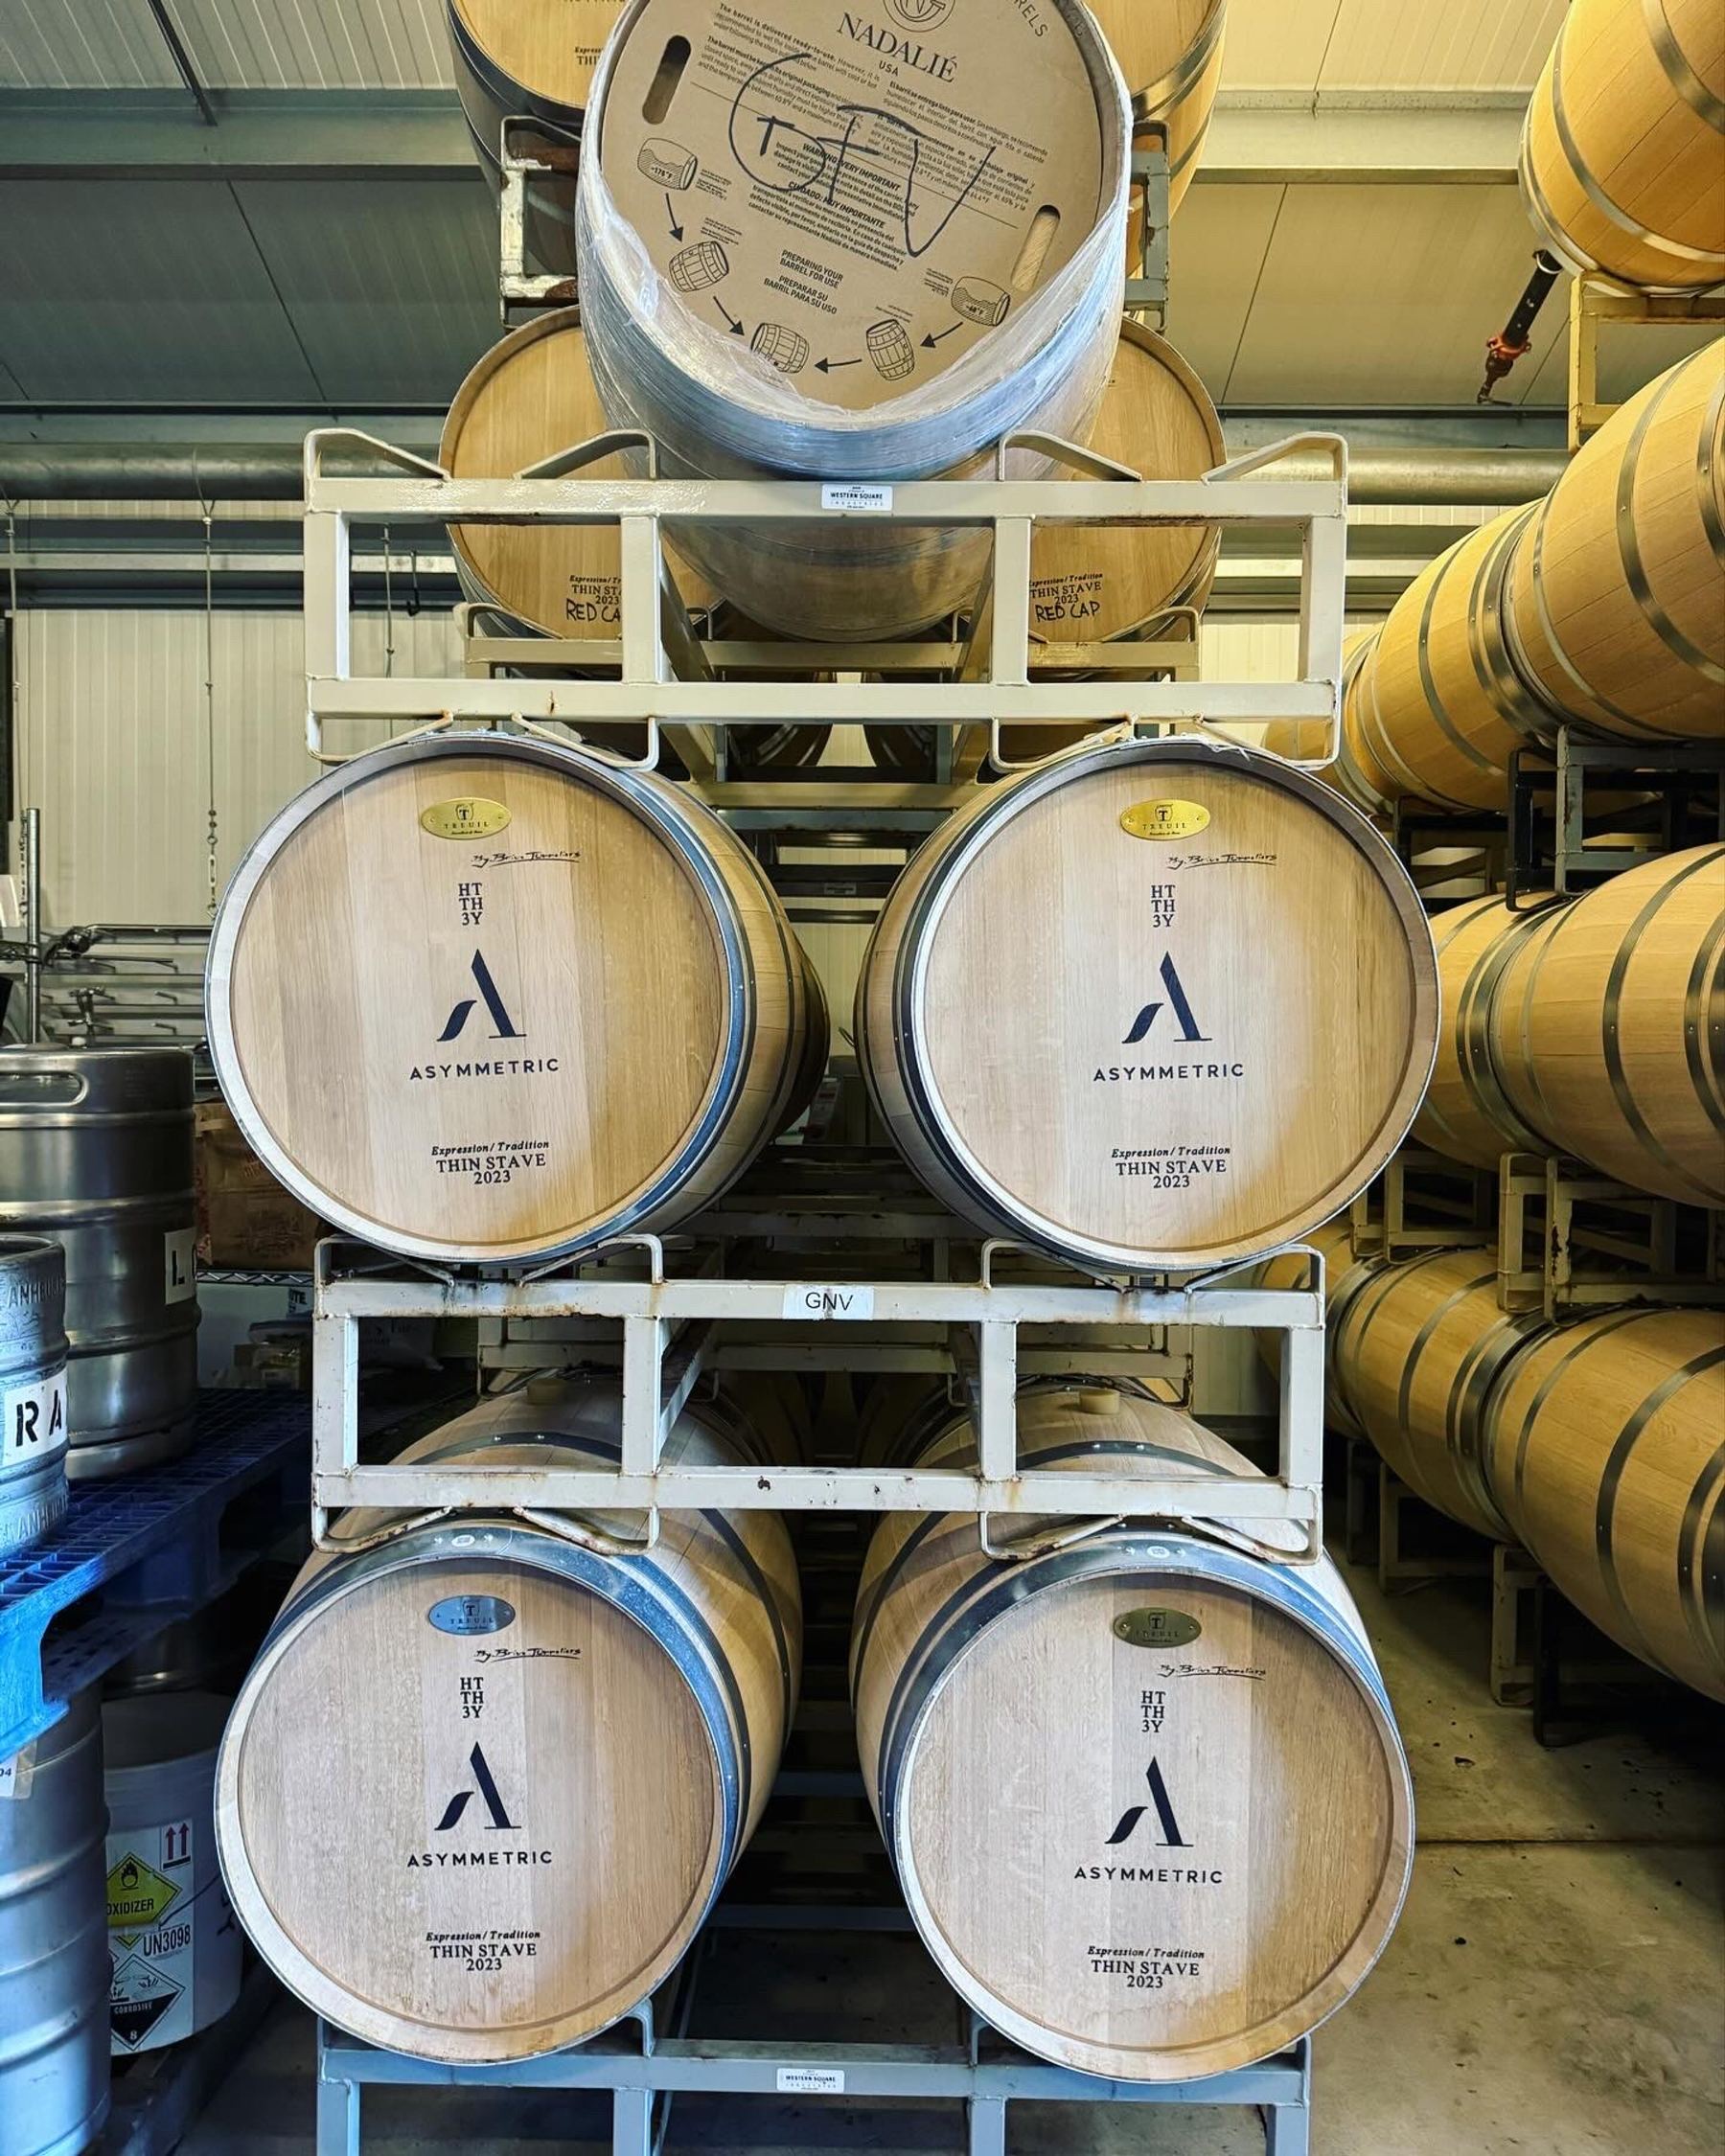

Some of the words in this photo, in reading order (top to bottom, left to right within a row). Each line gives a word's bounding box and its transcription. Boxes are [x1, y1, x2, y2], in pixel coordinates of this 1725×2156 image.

[836, 12, 958, 83] NADALIÉ
[879, 60, 900, 77] USA
[858, 168, 901, 192] IMPORTANT
[839, 202, 886, 228] IMPORTANTE
[778, 257, 809, 275] BARREL
[807, 269, 825, 282] FOR
[823, 276, 840, 288] USE
[780, 248, 824, 273] PREPARING
[821, 266, 843, 282] YOUR
[762, 277, 791, 294] BARRIL
[790, 288, 811, 303] PARA
[809, 297, 822, 308] SU
[820, 302, 838, 314] USO
[777, 274, 817, 297] PREPARAR
[816, 290, 829, 302] SU
[571, 584, 602, 595] THIN
[1029, 585, 1059, 599] THIN
[1062, 581, 1102, 595] STAVE
[595, 595, 619, 606] 2023
[1054, 594, 1079, 605] 2023
[565, 598, 597, 622] RED
[1035, 604, 1066, 623] RED
[1070, 600, 1101, 619] CAP
[444, 821, 490, 830] TREUIL
[458, 883, 482, 897] HT
[1151, 884, 1176, 899] HT
[459, 897, 483, 910] TH
[1151, 899, 1176, 913] TH
[462, 912, 483, 926] 3Y
[1153, 914, 1175, 928] 3Y
[409, 1058, 560, 1080] ASYMMETRIC
[1092, 1063, 1244, 1082] ASYMMETRIC
[496, 1140, 549, 1153] Tradition
[1177, 1145, 1230, 1157] Tradition
[436, 1158, 481, 1174] THIN
[486, 1153, 546, 1171] STAVE
[1116, 1161, 1161, 1177] THIN
[1165, 1158, 1227, 1174] STAVE
[473, 1170, 512, 1185] 2023
[1153, 1175, 1190, 1189] 2023
[805, 1292, 854, 1311] GNV
[460, 1677, 484, 1690] HT
[460, 1691, 484, 1705] TH
[1141, 1690, 1166, 1705] HT
[462, 1706, 483, 1719] 3Y
[1140, 1705, 1165, 1719] TH
[1141, 1719, 1163, 1733] 3Y
[406, 1850, 553, 1869] ASYMMETRIC
[1073, 1866, 1223, 1884] ASYMMETRIC
[106, 1898, 154, 1915] OXIDIZER
[144, 1924, 191, 1957] UN3098
[490, 1930, 540, 1940] Tradition
[429, 1944, 473, 1960] THIN
[478, 1942, 537, 1958] STAVE
[1152, 1947, 1205, 1959] Tradition
[466, 1958, 502, 1972] 2023
[1091, 1960, 1136, 1974] THIN
[1138, 1961, 1200, 1976] STAVE
[1126, 1974, 1163, 1989] 2023
[114, 2001, 153, 2014] CORROSIVE
[129, 2030, 138, 2040] 8
